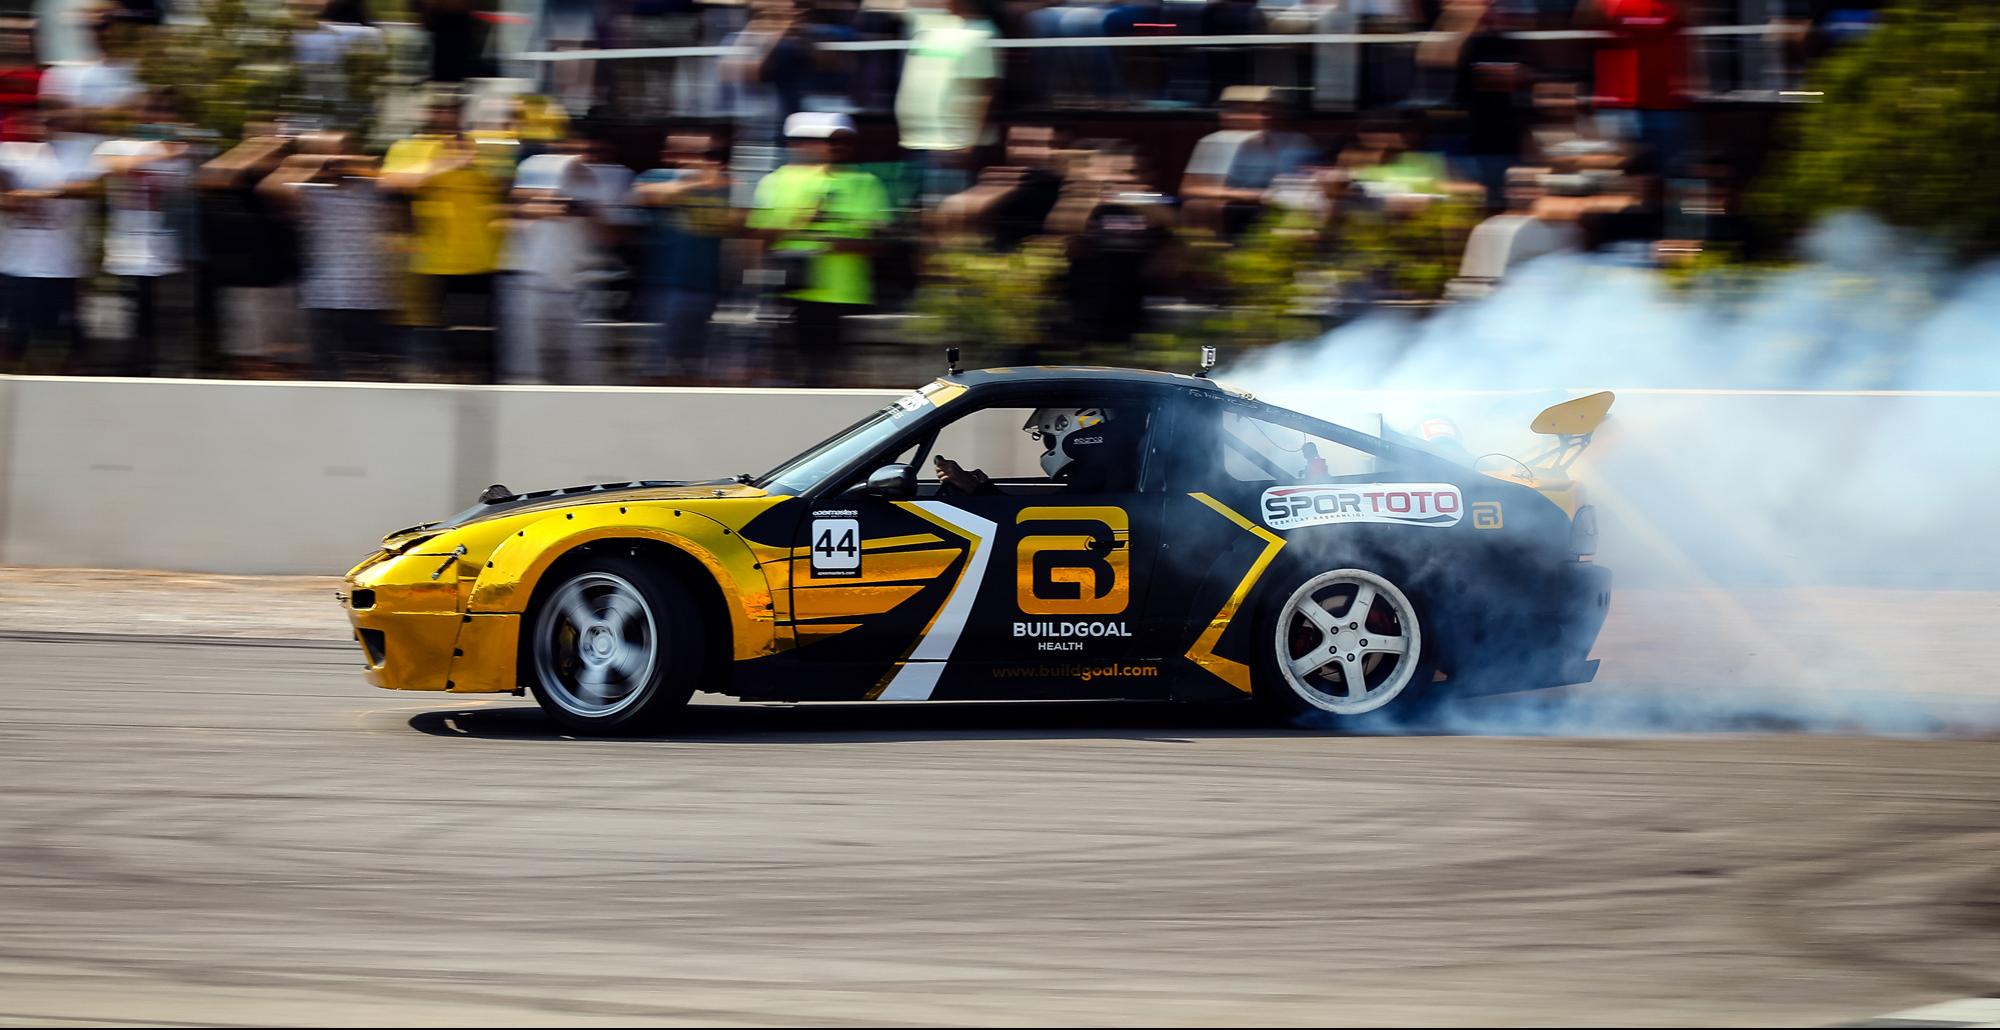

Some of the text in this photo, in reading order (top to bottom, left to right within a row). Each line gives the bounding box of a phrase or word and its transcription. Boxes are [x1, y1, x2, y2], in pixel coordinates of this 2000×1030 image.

[815, 528, 857, 558] 44
[1013, 621, 1132, 637] BUILDGOAL
[1038, 642, 1083, 651] HEALTH
[992, 663, 1158, 681] www.buildgoal.com
